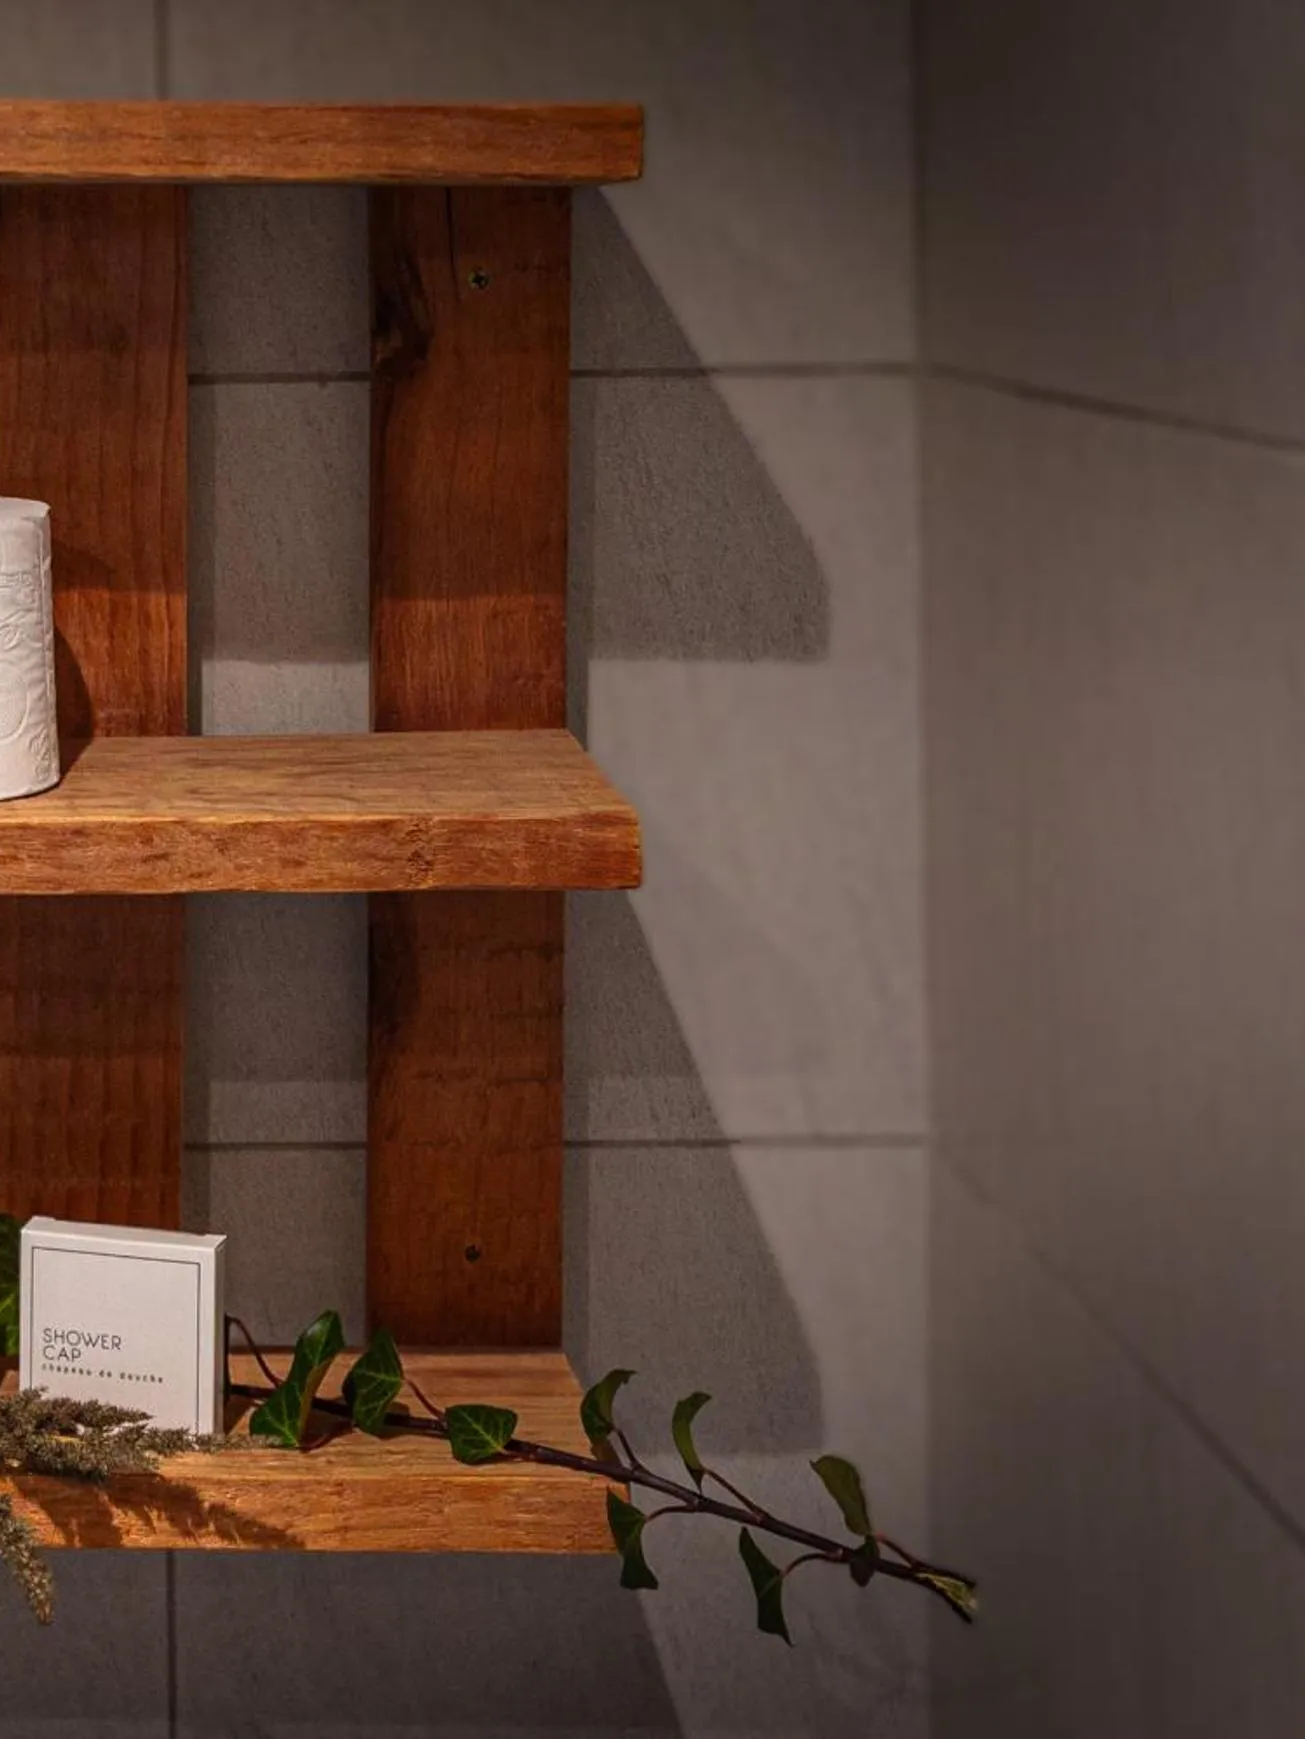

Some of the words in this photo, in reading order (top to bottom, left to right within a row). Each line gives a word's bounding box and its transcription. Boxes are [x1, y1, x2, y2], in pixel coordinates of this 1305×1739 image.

[42, 1327, 122, 1351] SHOWER
[42, 1344, 82, 1363] CAP
[99, 1369, 113, 1379] de
